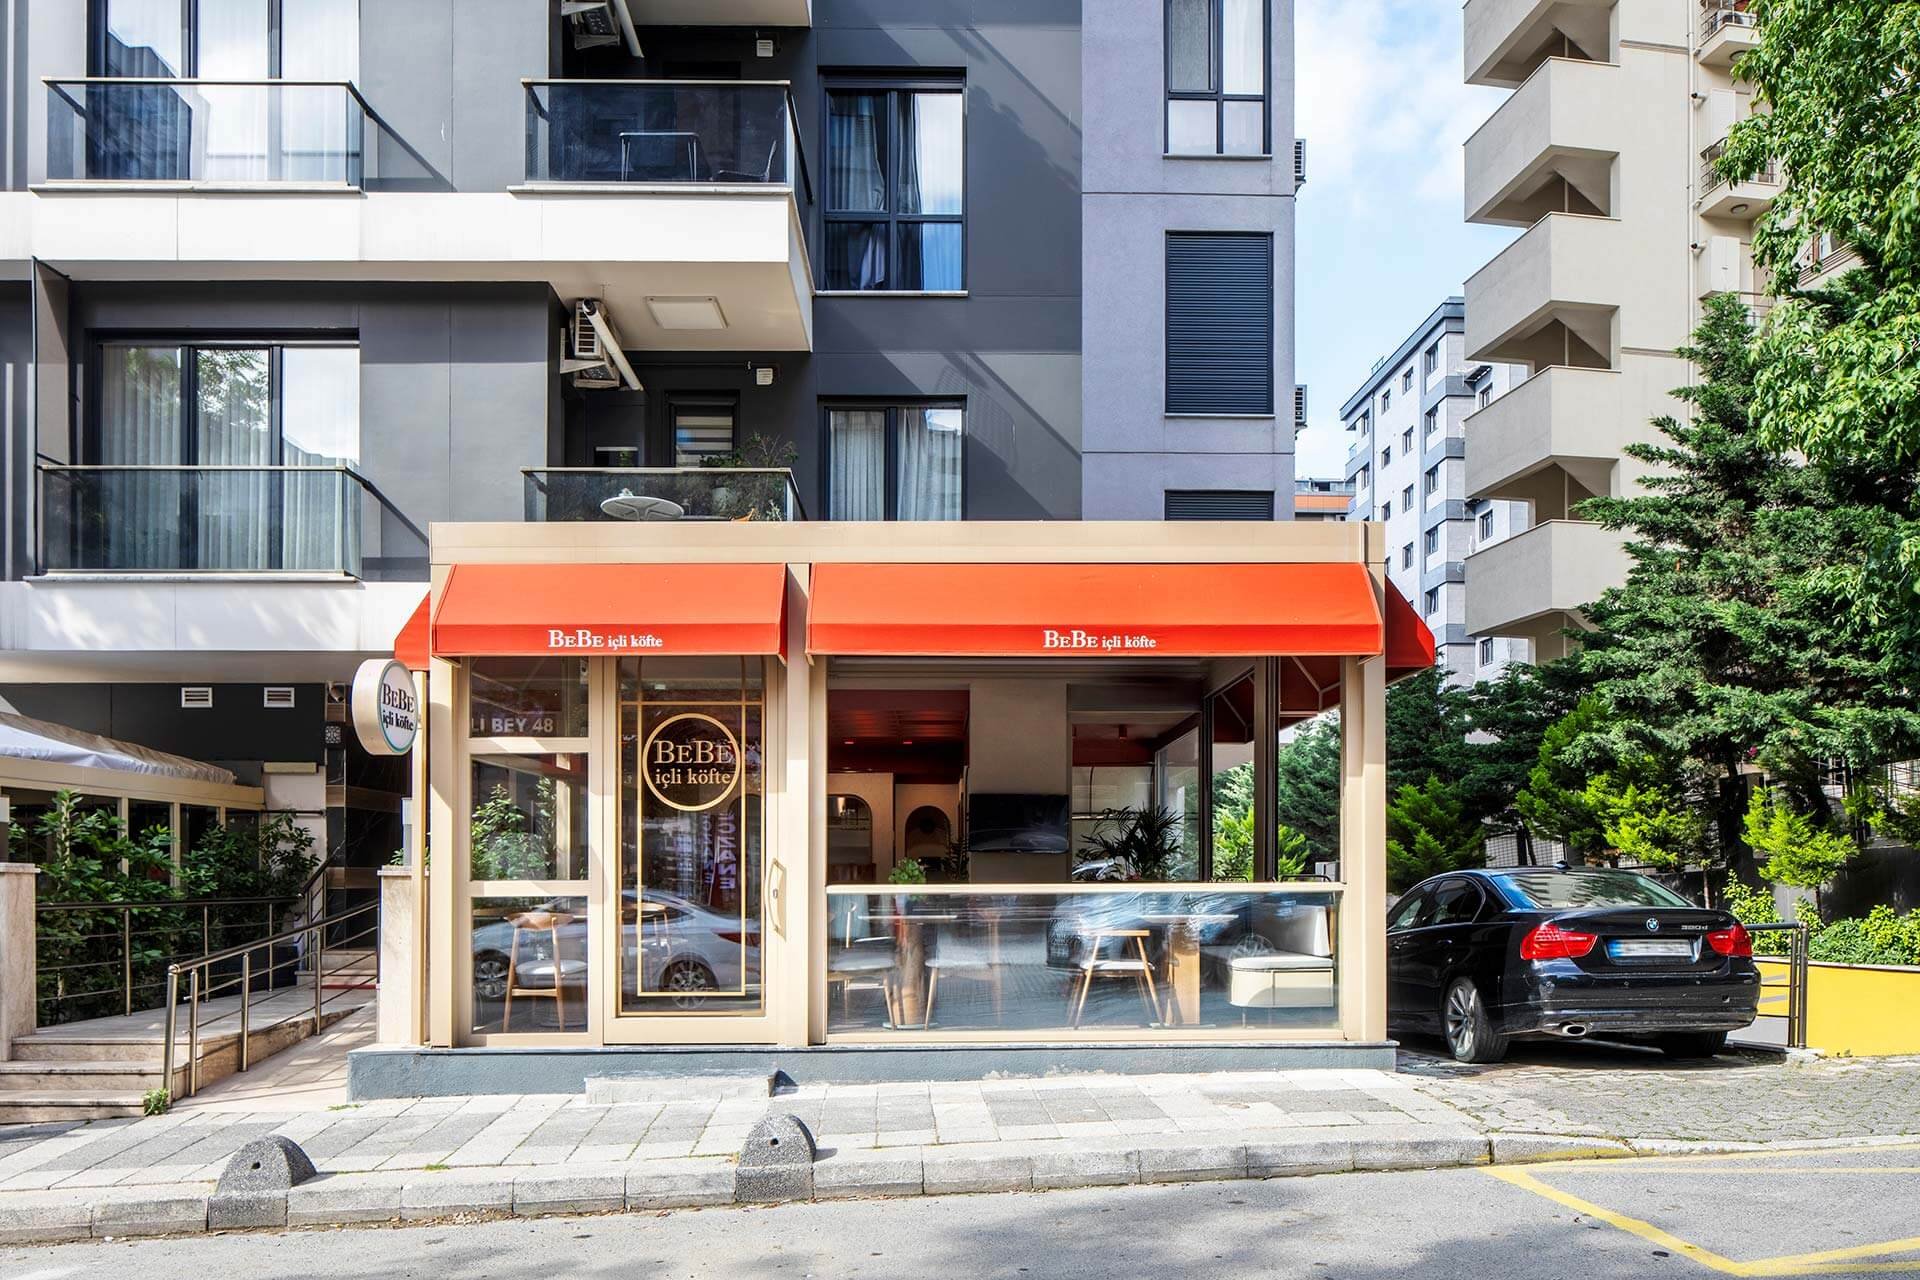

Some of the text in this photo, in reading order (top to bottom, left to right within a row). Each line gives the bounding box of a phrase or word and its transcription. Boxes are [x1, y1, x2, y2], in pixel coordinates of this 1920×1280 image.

[608, 634, 628, 651] içli
[630, 634, 664, 648] köfte
[1102, 635, 1121, 651] içli
[1124, 635, 1157, 648] köfte
[382, 709, 414, 731] içli köfte
[491, 717, 527, 733] BEY
[532, 717, 554, 733] 48
[655, 768, 731, 789] içli köfte
